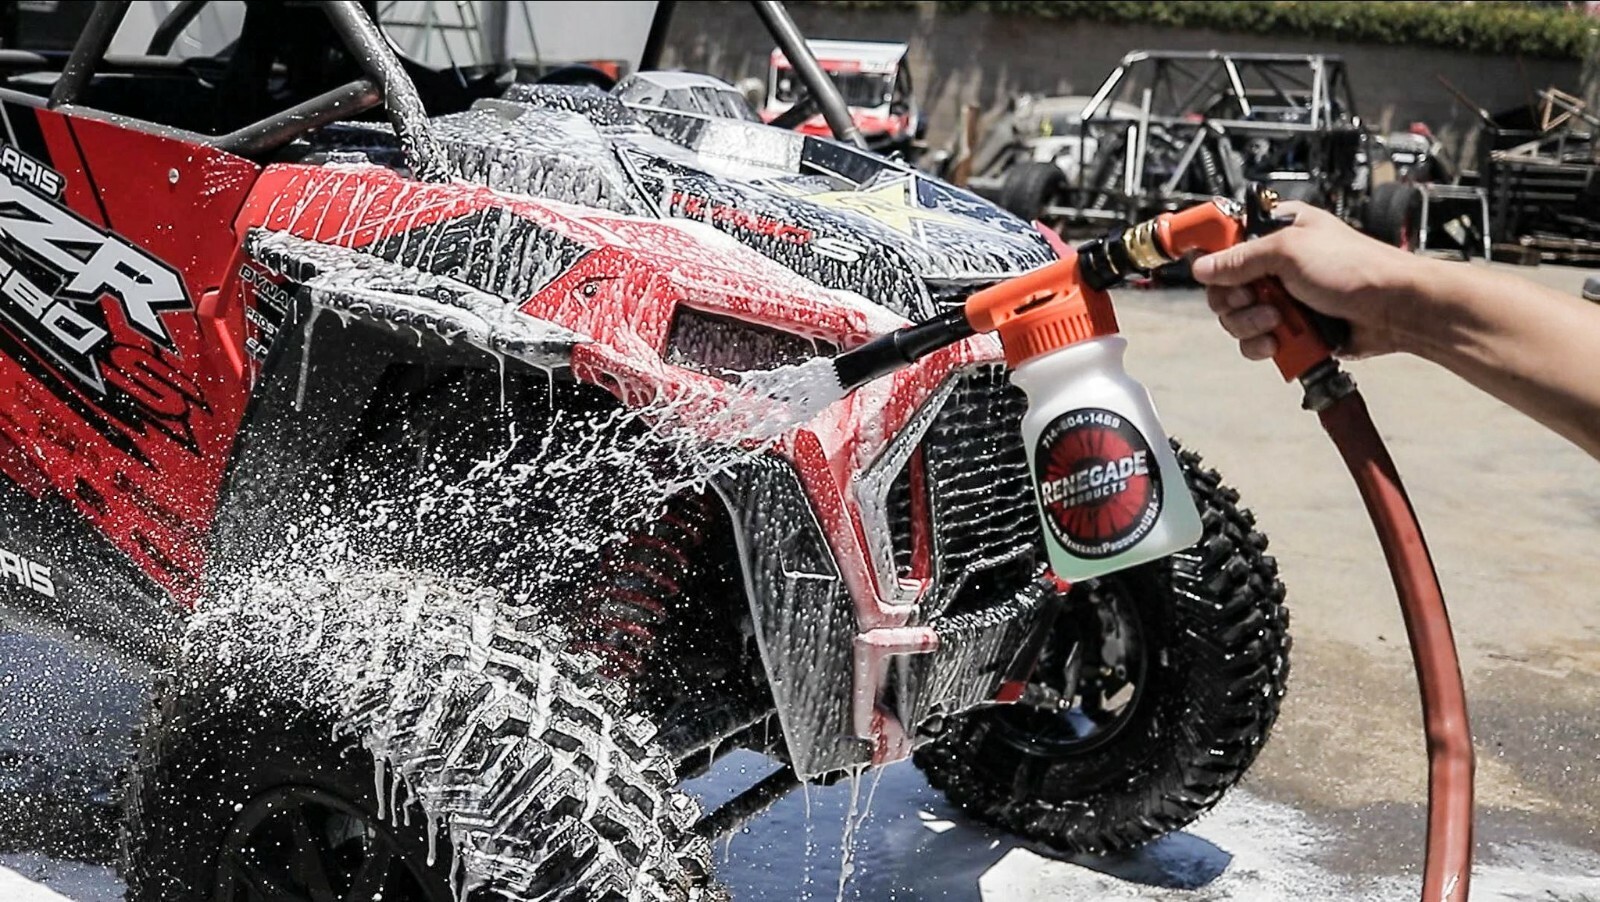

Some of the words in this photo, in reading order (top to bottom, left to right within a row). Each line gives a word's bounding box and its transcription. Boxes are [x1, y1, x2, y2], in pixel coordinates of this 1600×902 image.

[0, 147, 60, 196] ARIS
[0, 173, 186, 341] ZR
[1041, 450, 1149, 506] RENEGADE
[1063, 481, 1127, 509] PRODUCTS
[0, 548, 56, 598] RIS
